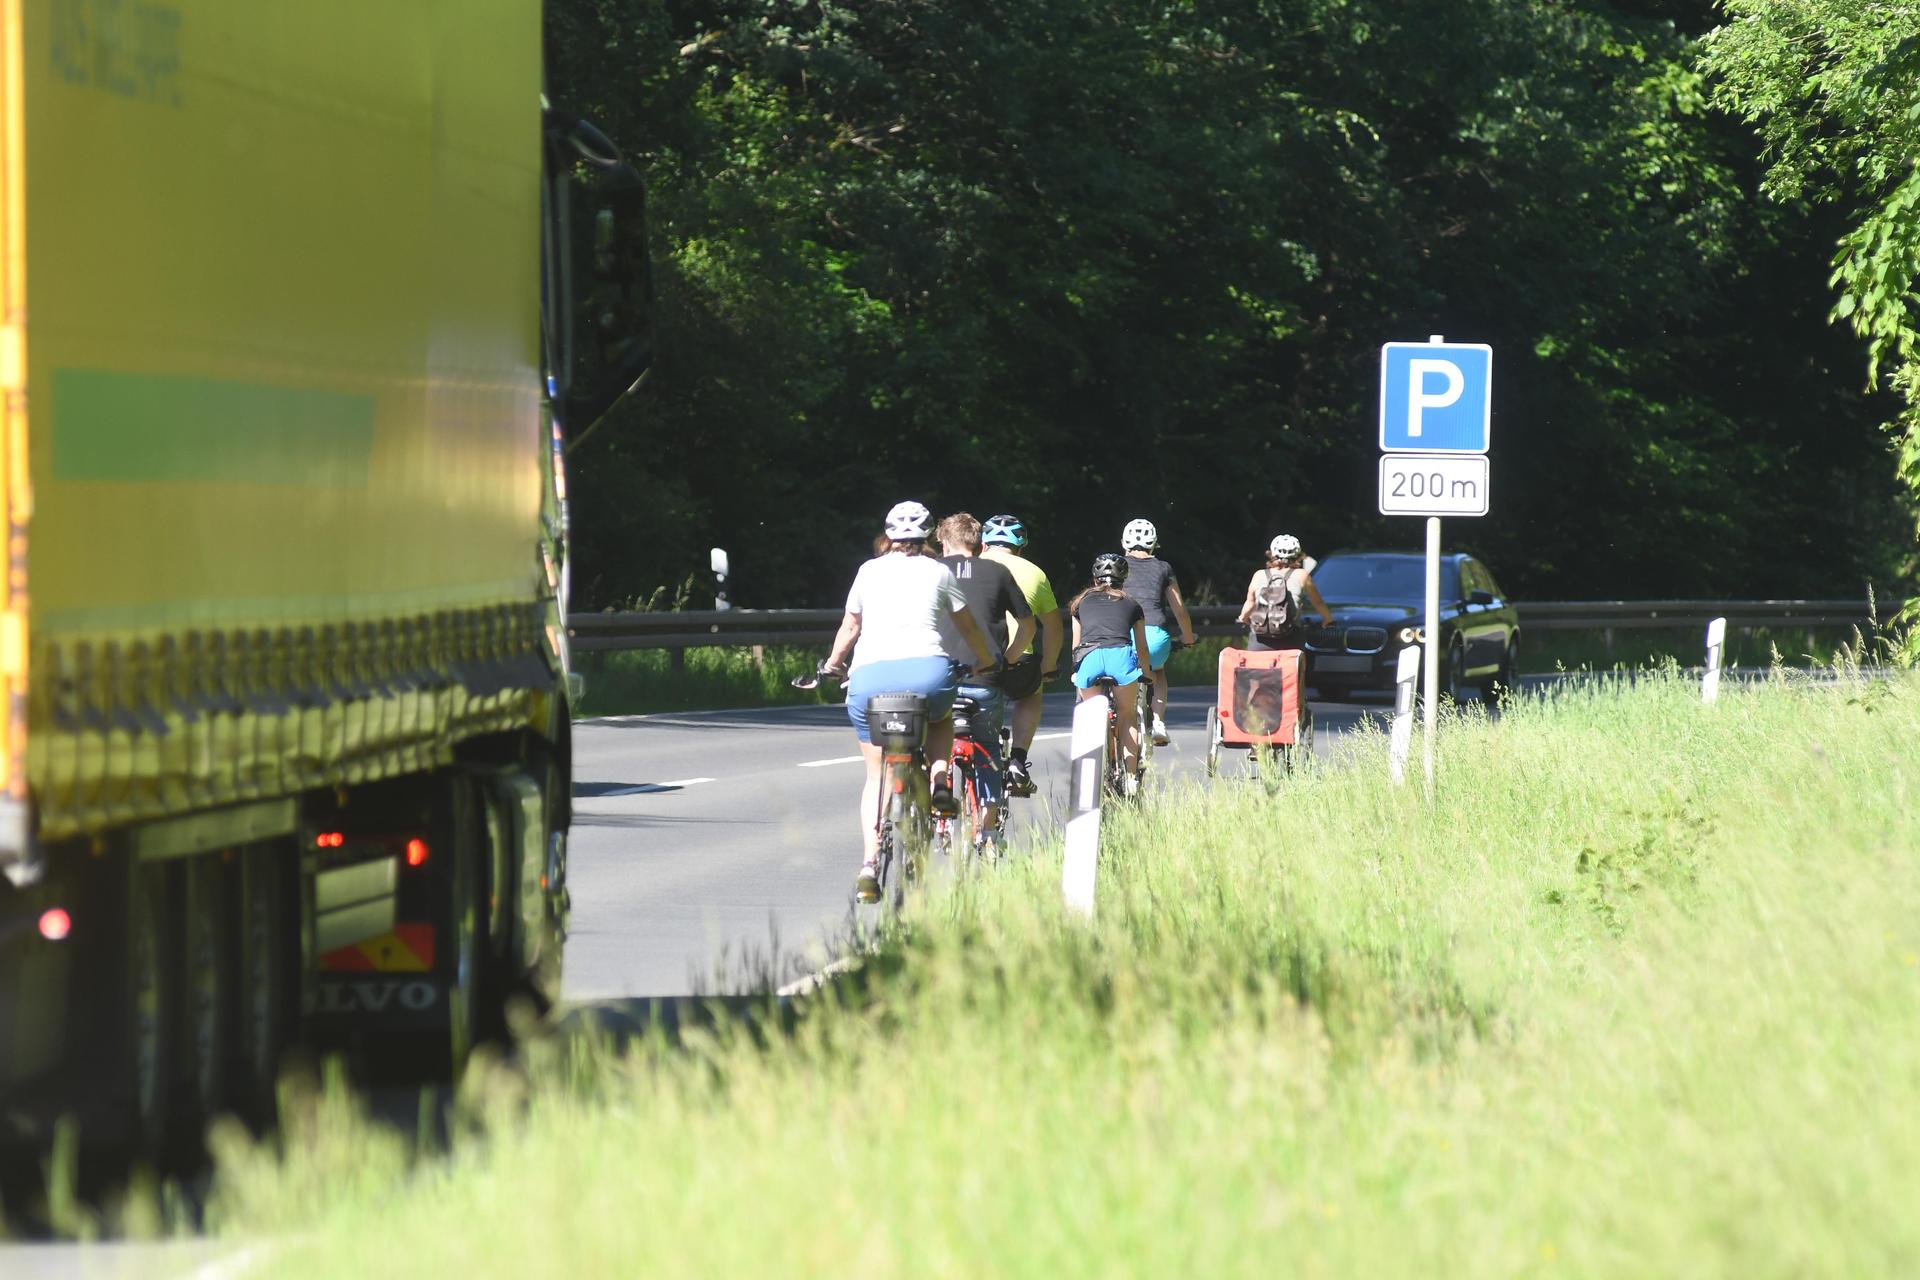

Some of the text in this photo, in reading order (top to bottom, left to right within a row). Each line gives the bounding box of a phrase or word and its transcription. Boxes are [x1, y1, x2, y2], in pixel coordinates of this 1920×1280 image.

[1407, 358, 1465, 437] P
[1391, 472, 1477, 498] 200 m
[317, 981, 436, 1010] LVO
